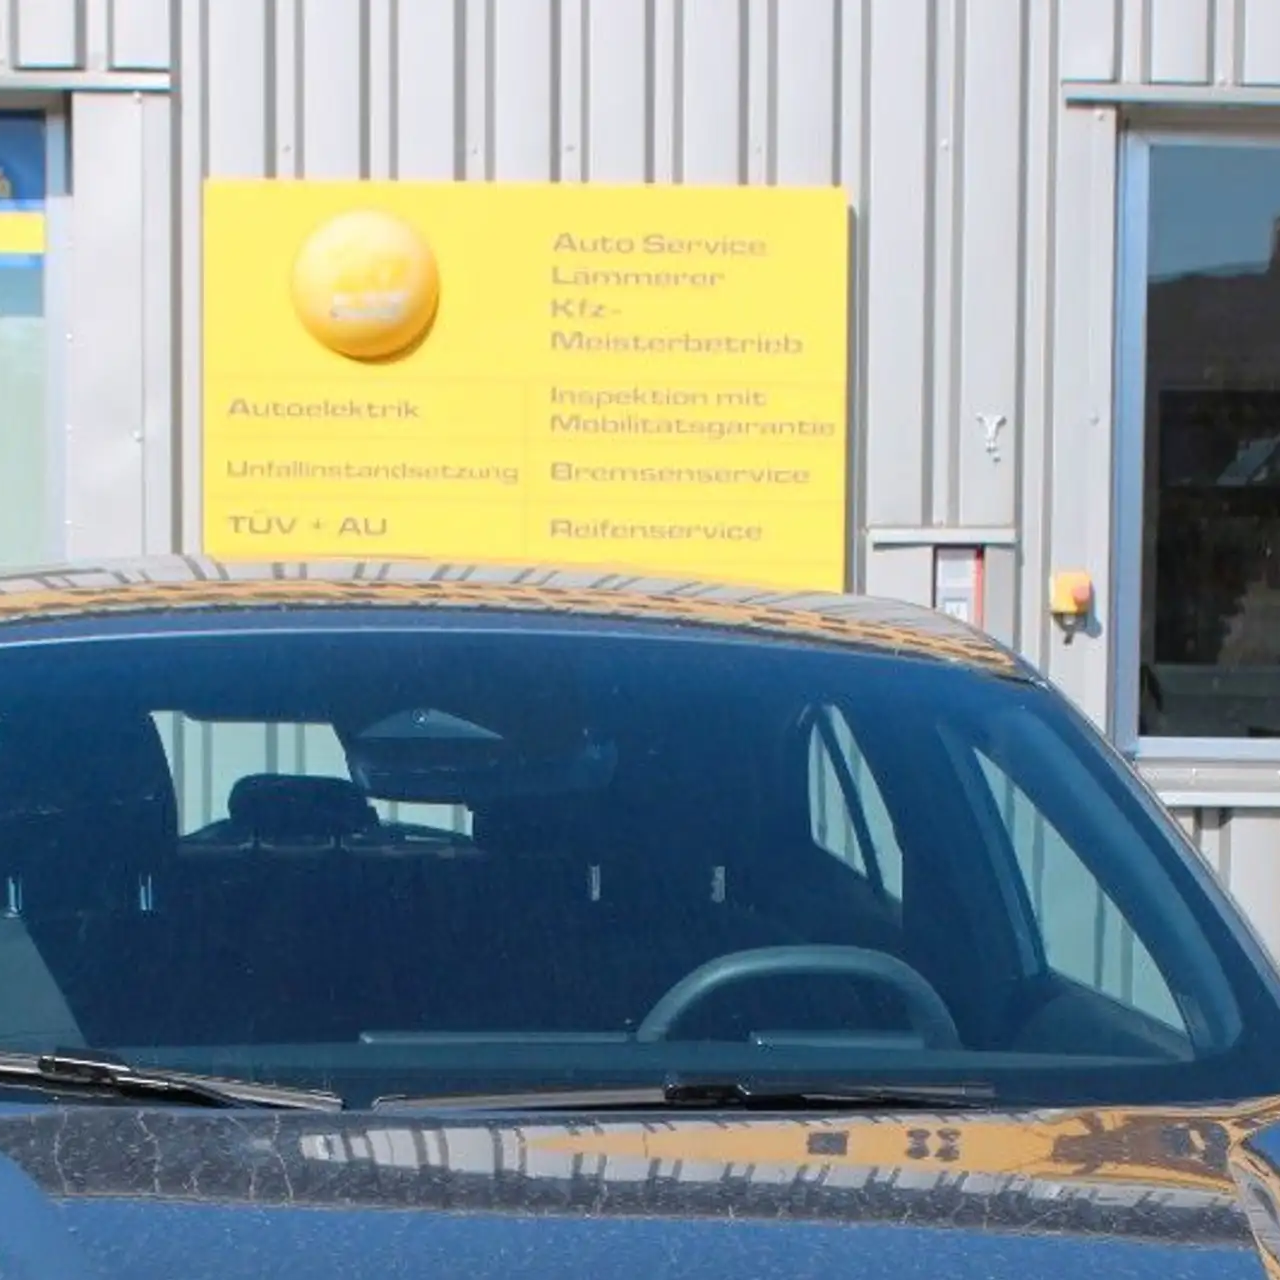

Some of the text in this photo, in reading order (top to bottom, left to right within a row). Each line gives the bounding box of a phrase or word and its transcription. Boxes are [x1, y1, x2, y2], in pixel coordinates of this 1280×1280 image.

[553, 232, 767, 257] Auto Service
[550, 299, 623, 319] Kfz-
[550, 330, 804, 354] Meisterbetrieb
[227, 397, 420, 419] Autoelektrik
[550, 386, 768, 409] Inspektion mit
[226, 460, 519, 484] Unfallinstandsetzung
[550, 462, 812, 484] Bremsenservice
[337, 517, 389, 536] AU
[550, 518, 764, 541] Reifenservice
